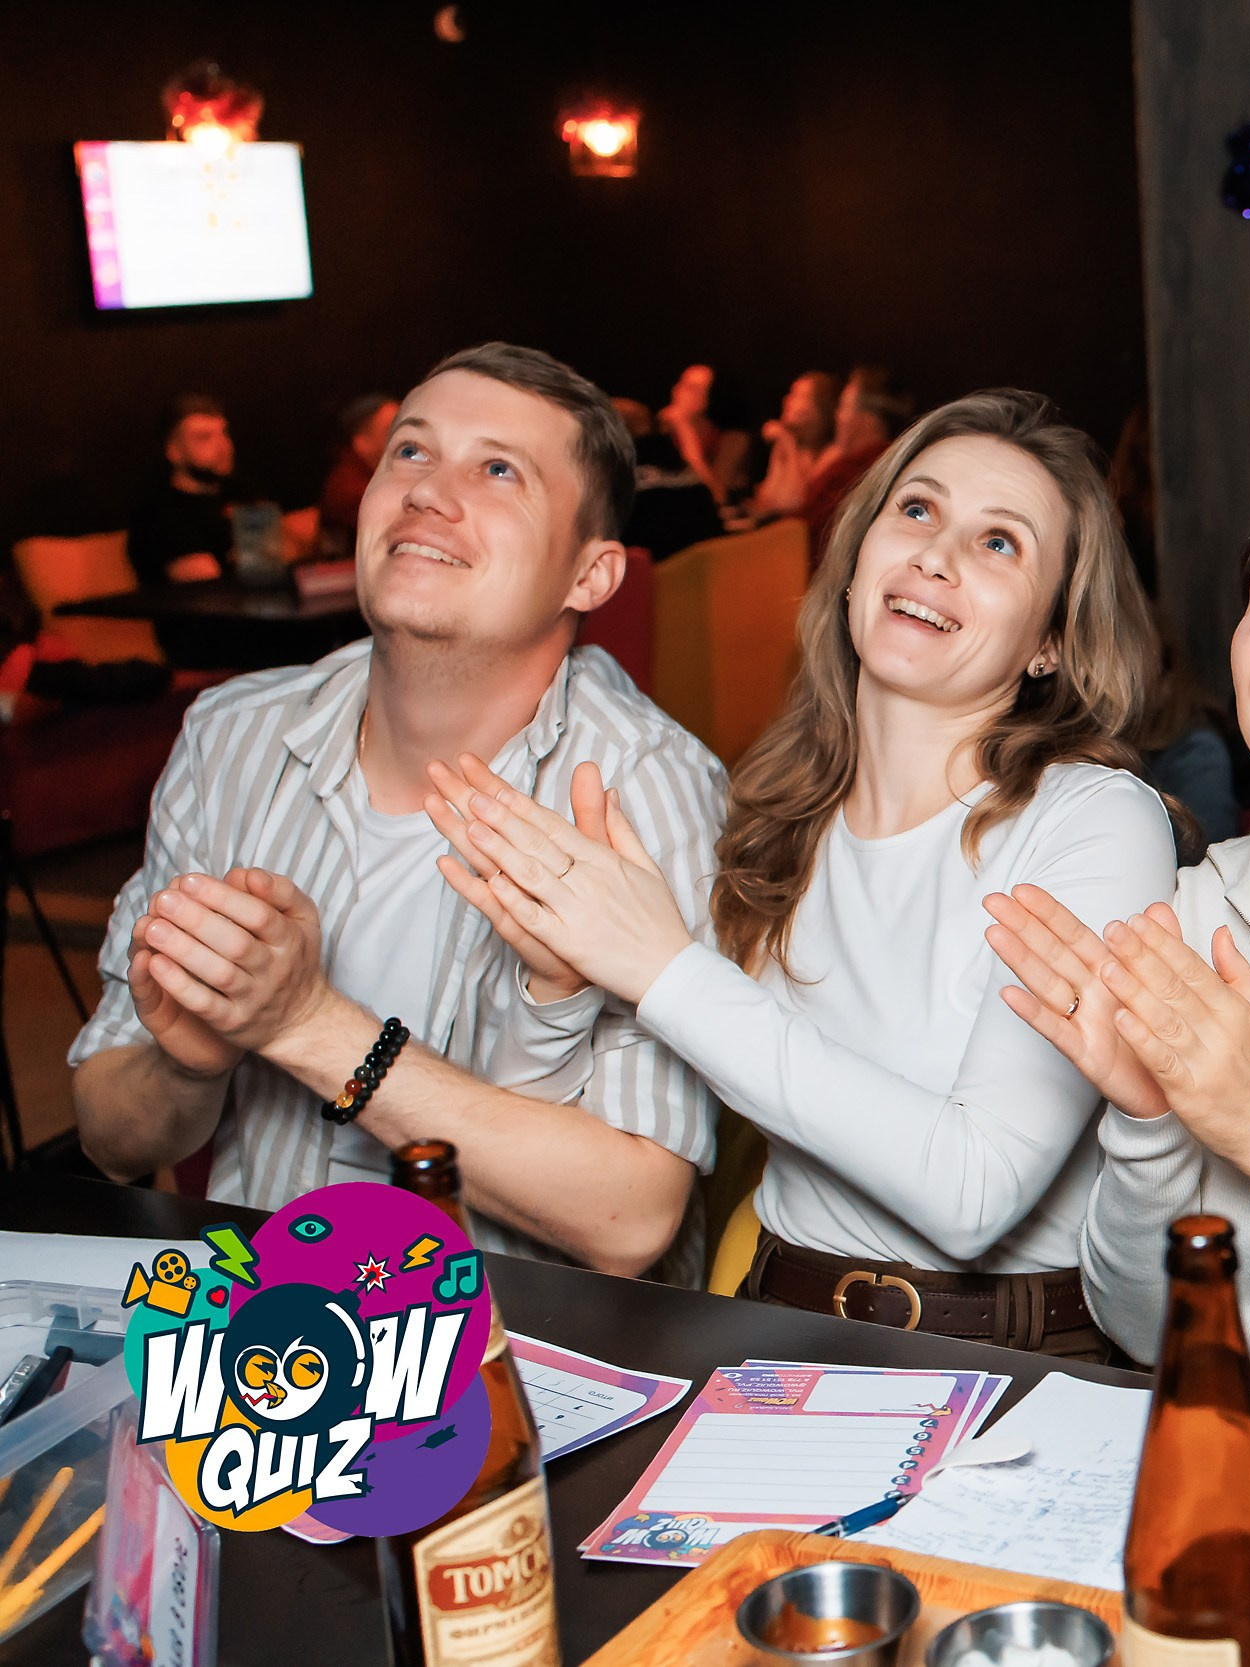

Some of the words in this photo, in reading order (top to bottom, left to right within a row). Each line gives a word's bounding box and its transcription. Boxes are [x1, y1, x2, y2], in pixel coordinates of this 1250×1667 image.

[588, 1390, 614, 1401] ИТОГО
[923, 1419, 934, 1427] 7
[916, 1432, 929, 1441] 6
[910, 1446, 922, 1455] 5
[903, 1461, 916, 1469] 4
[895, 1476, 908, 1484] 3
[649, 1517, 707, 1531] QUIZ
[611, 1528, 720, 1551] WOW
